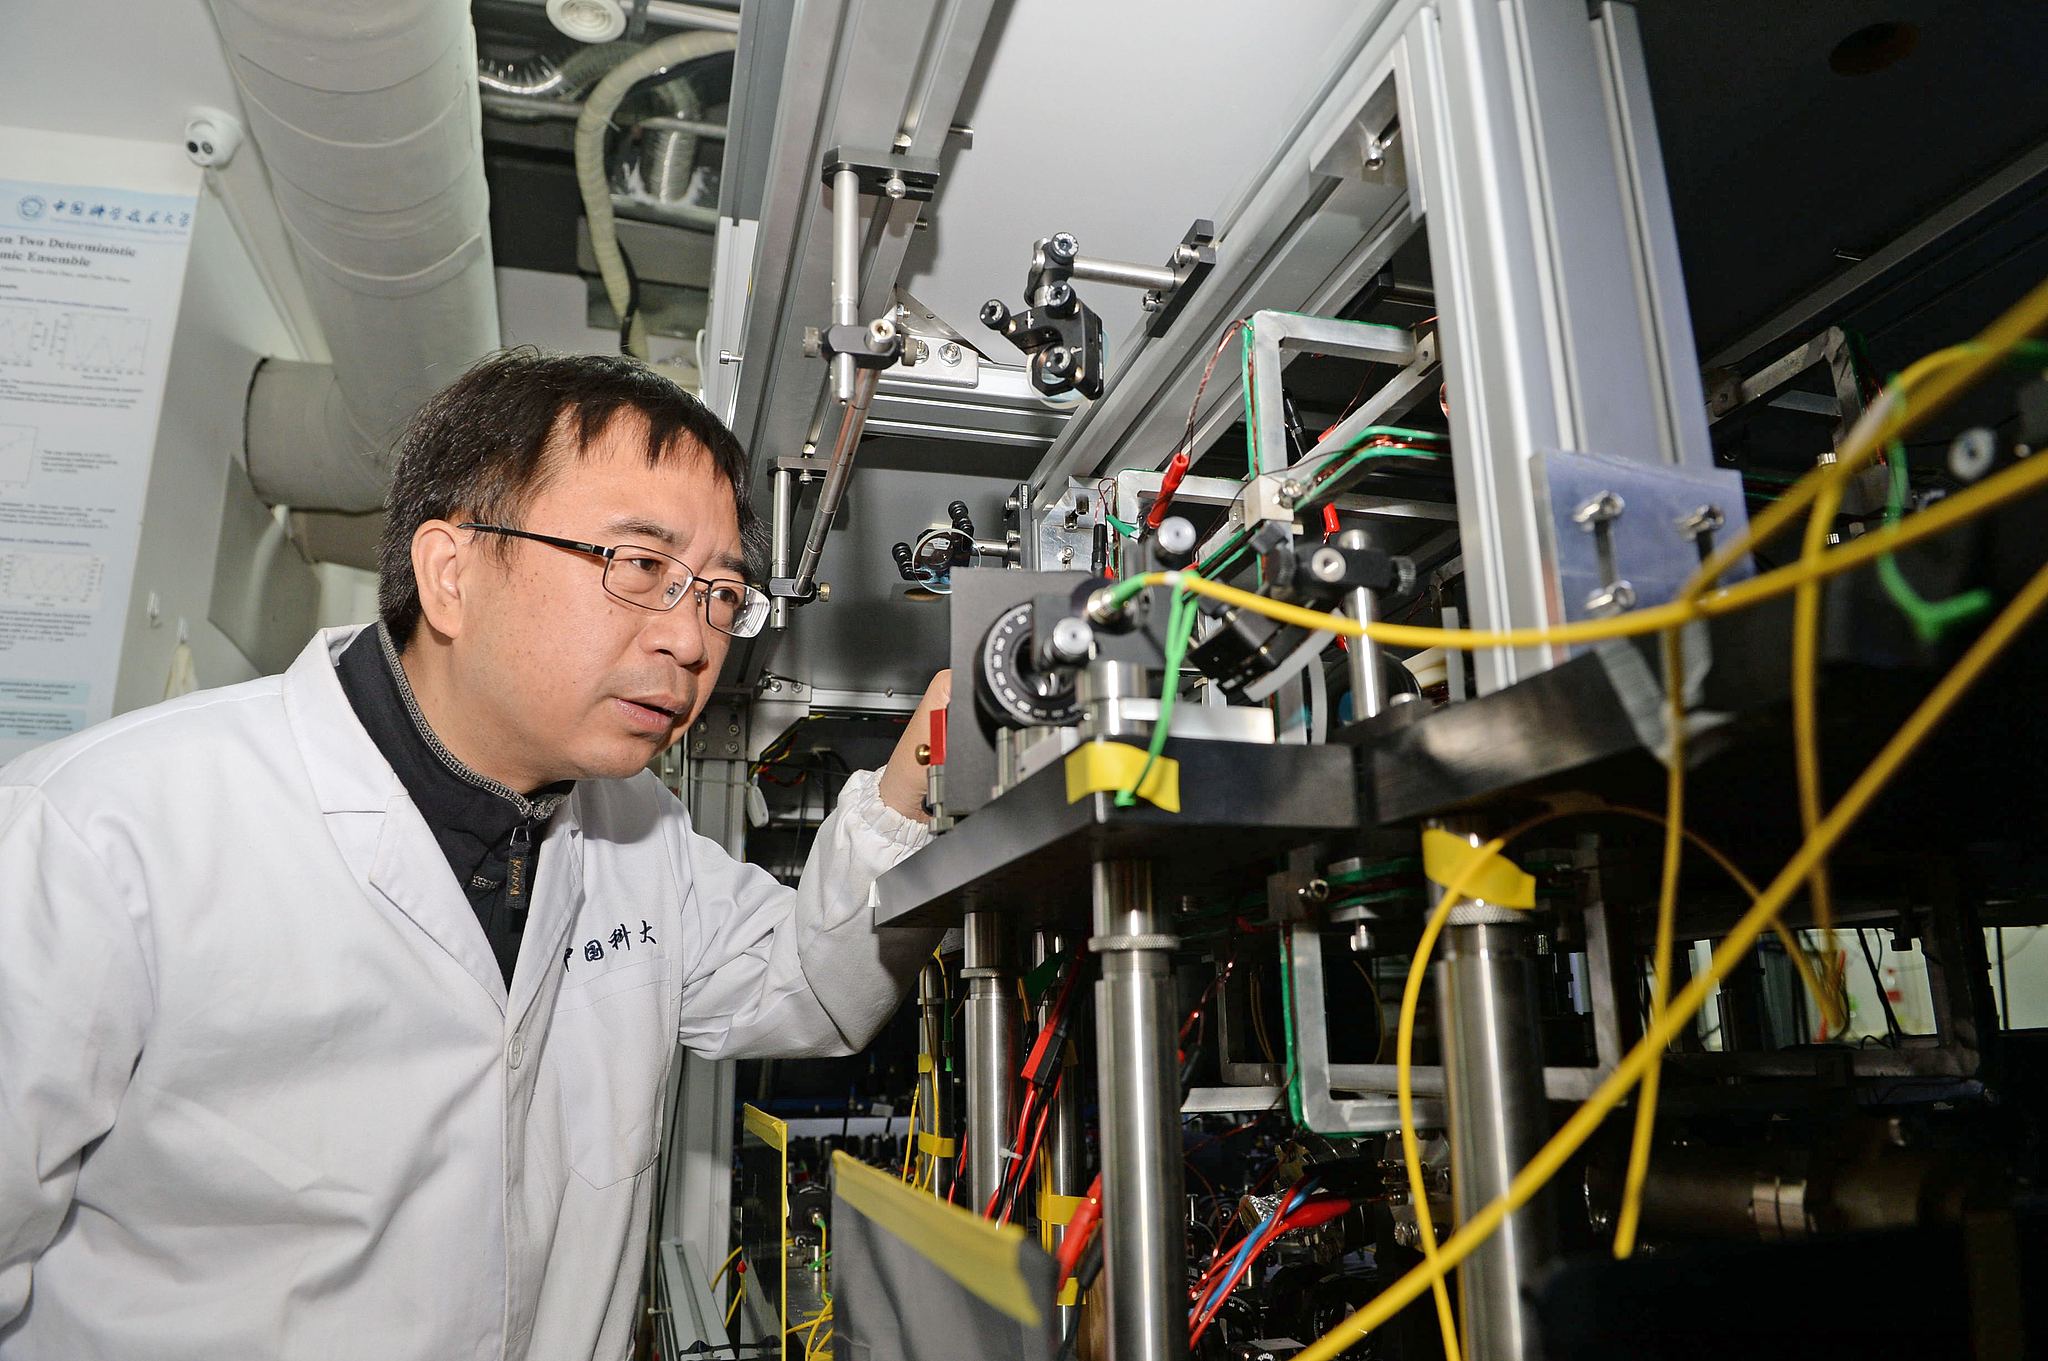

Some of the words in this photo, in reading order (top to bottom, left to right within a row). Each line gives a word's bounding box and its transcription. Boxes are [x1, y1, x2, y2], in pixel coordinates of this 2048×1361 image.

[20, 236, 44, 246] Two
[50, 238, 136, 257] Deterministic
[28, 252, 90, 266] Ensemble
